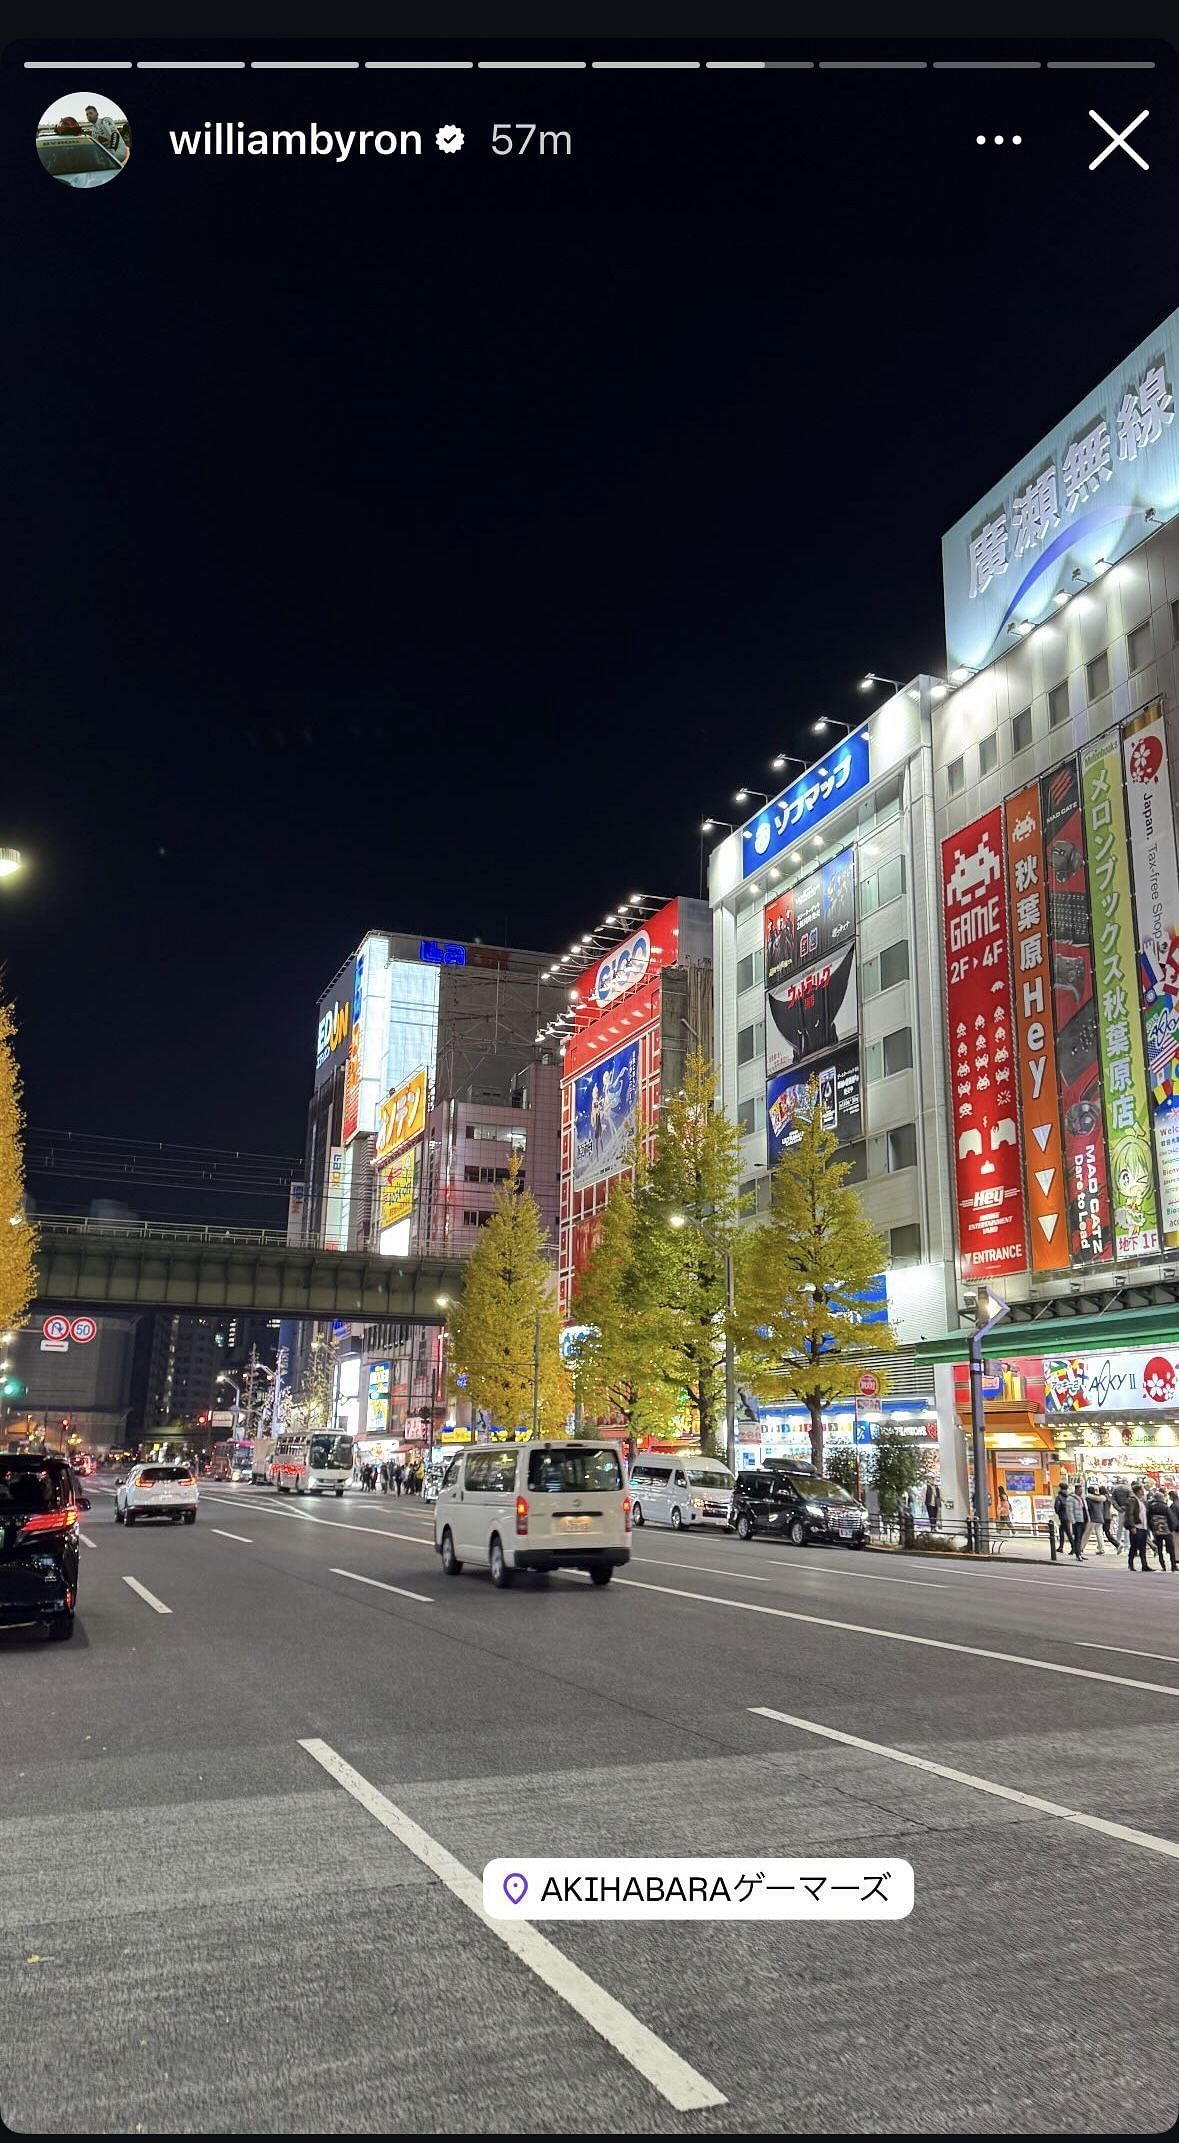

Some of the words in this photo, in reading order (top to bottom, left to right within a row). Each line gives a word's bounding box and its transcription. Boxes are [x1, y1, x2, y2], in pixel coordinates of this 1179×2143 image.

[1143, 793, 1155, 841] Japan.
[1152, 903, 1164, 939] Shop
[950, 895, 1000, 953] GAME
[1091, 768, 1138, 1131] メロンブックス秋葉原店
[950, 956, 969, 984] 2F
[982, 938, 1004, 967] 4F
[1085, 1144, 1098, 1193] MAD
[1090, 1198, 1103, 1253] CATZ
[973, 1244, 1022, 1265] ENTRANCE
[76, 1324, 90, 1336] 50
